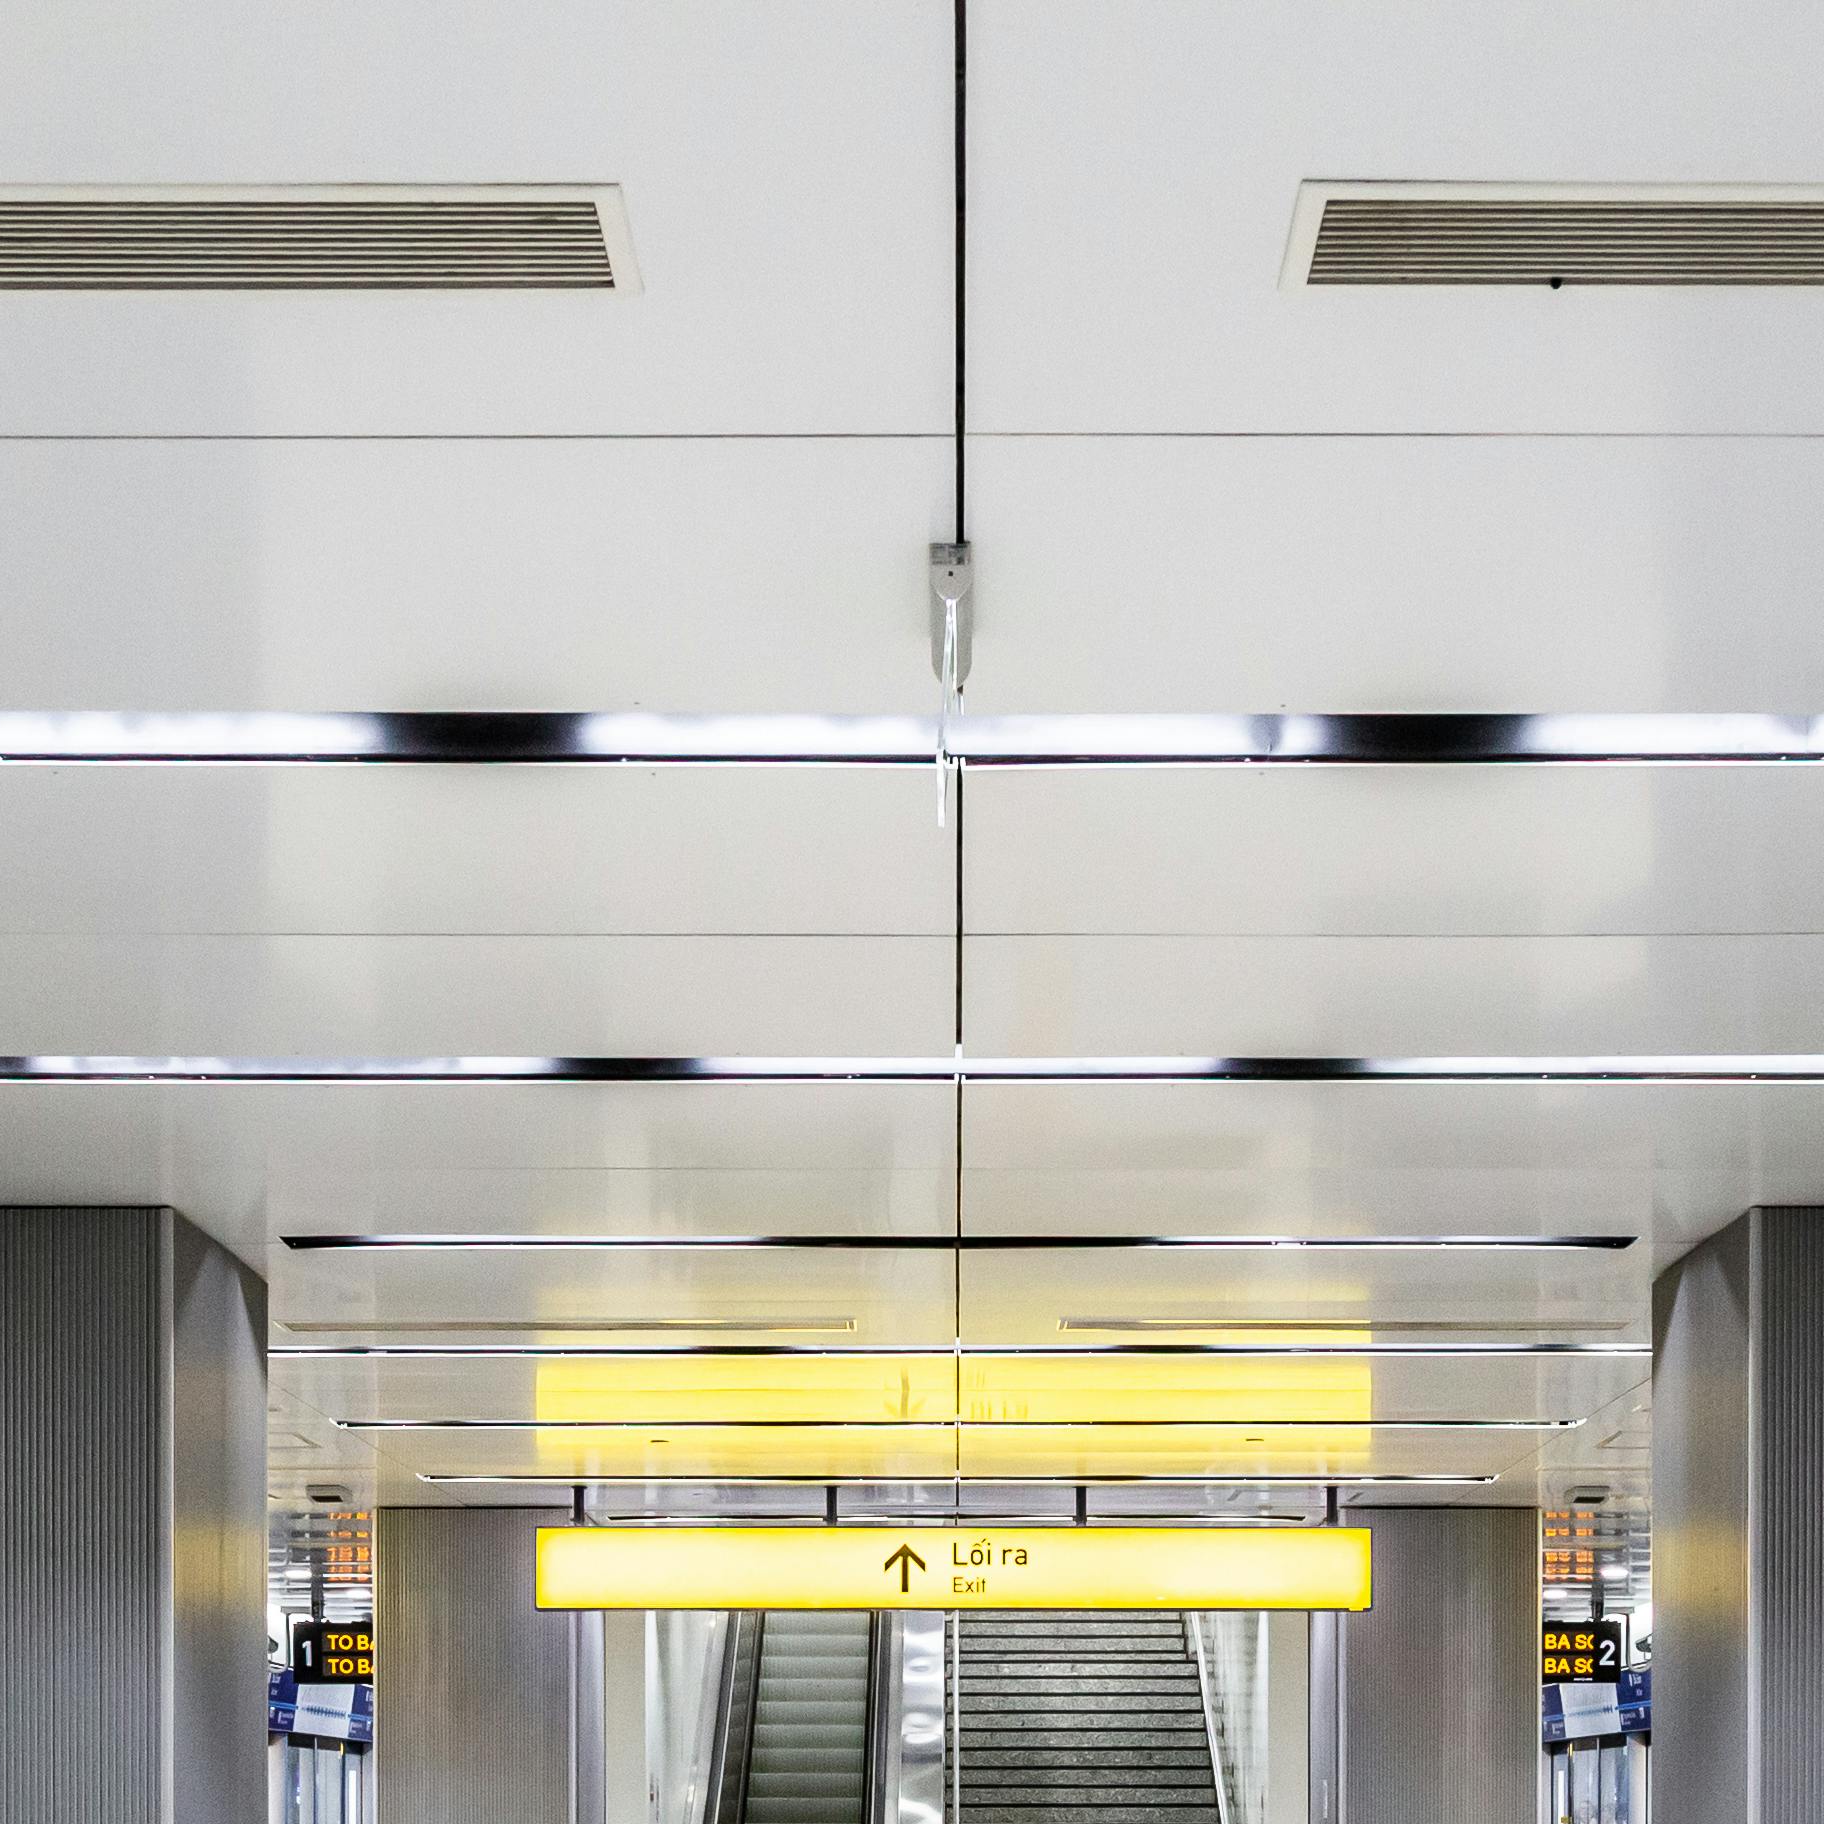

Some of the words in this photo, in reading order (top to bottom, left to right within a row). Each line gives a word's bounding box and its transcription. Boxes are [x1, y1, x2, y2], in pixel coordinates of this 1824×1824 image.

[953, 1538, 991, 1566] Lối
[1002, 1549, 1028, 1566] ra
[953, 1576, 987, 1593] Exit
[326, 1634, 354, 1651] TO
[1544, 1633, 1571, 1650] BA
[301, 1640, 313, 1667] 1
[1599, 1639, 1616, 1666] 2
[327, 1658, 354, 1674] TO
[357, 1658, 374, 1674] B
[1544, 1657, 1571, 1674] BA
